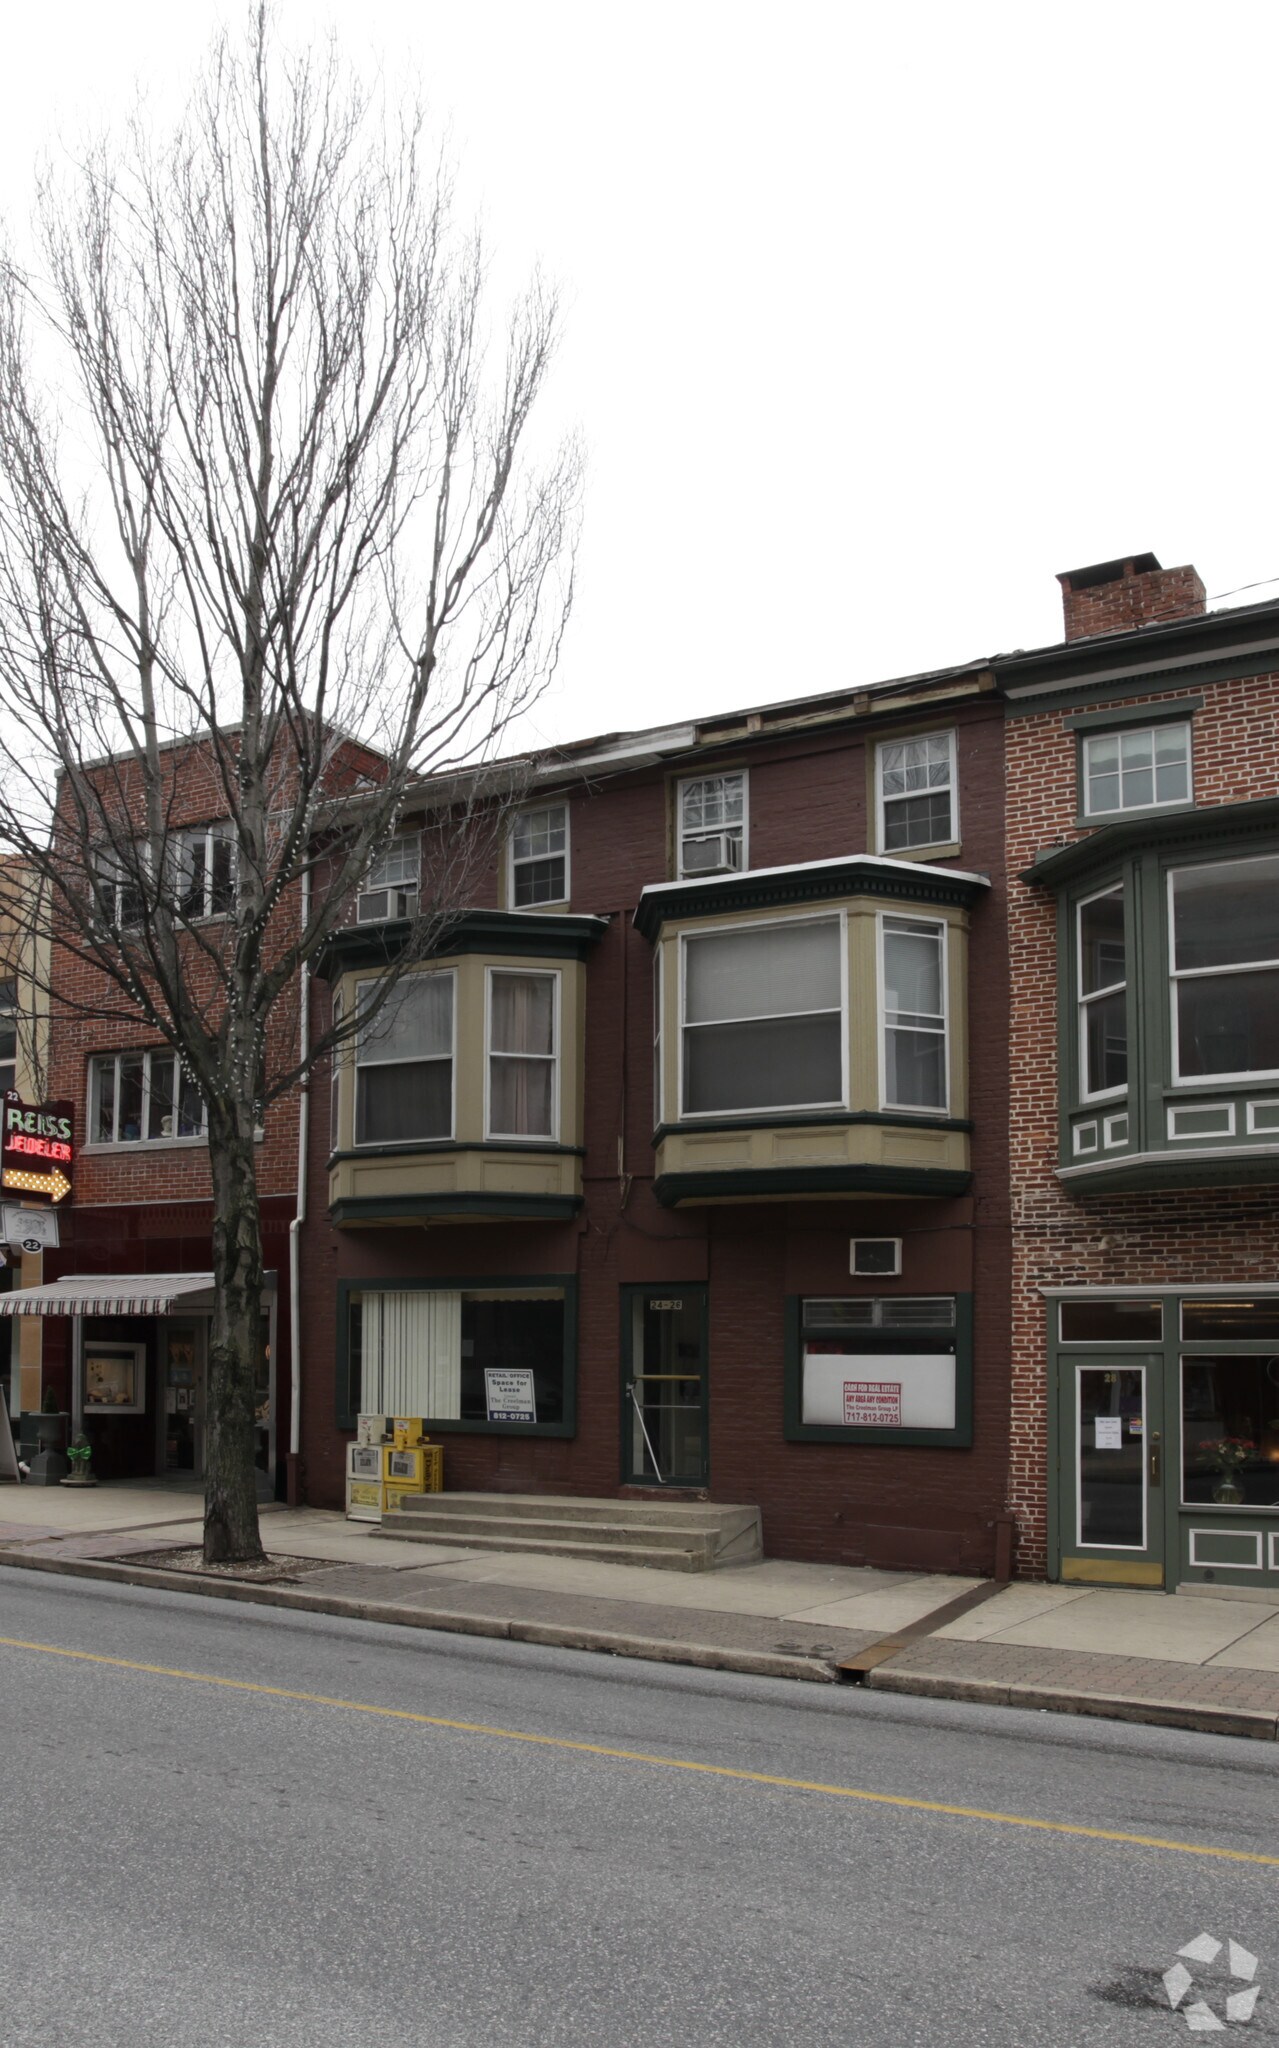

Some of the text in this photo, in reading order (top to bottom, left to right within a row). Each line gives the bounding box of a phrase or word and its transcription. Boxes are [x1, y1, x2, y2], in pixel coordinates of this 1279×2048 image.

[7, 1091, 18, 1101] 22
[7, 1108, 71, 1139] REISS
[25, 1241, 38, 1249] 22
[1104, 1373, 1117, 1383] 28
[847, 1412, 898, 1422] 717-812-0725
